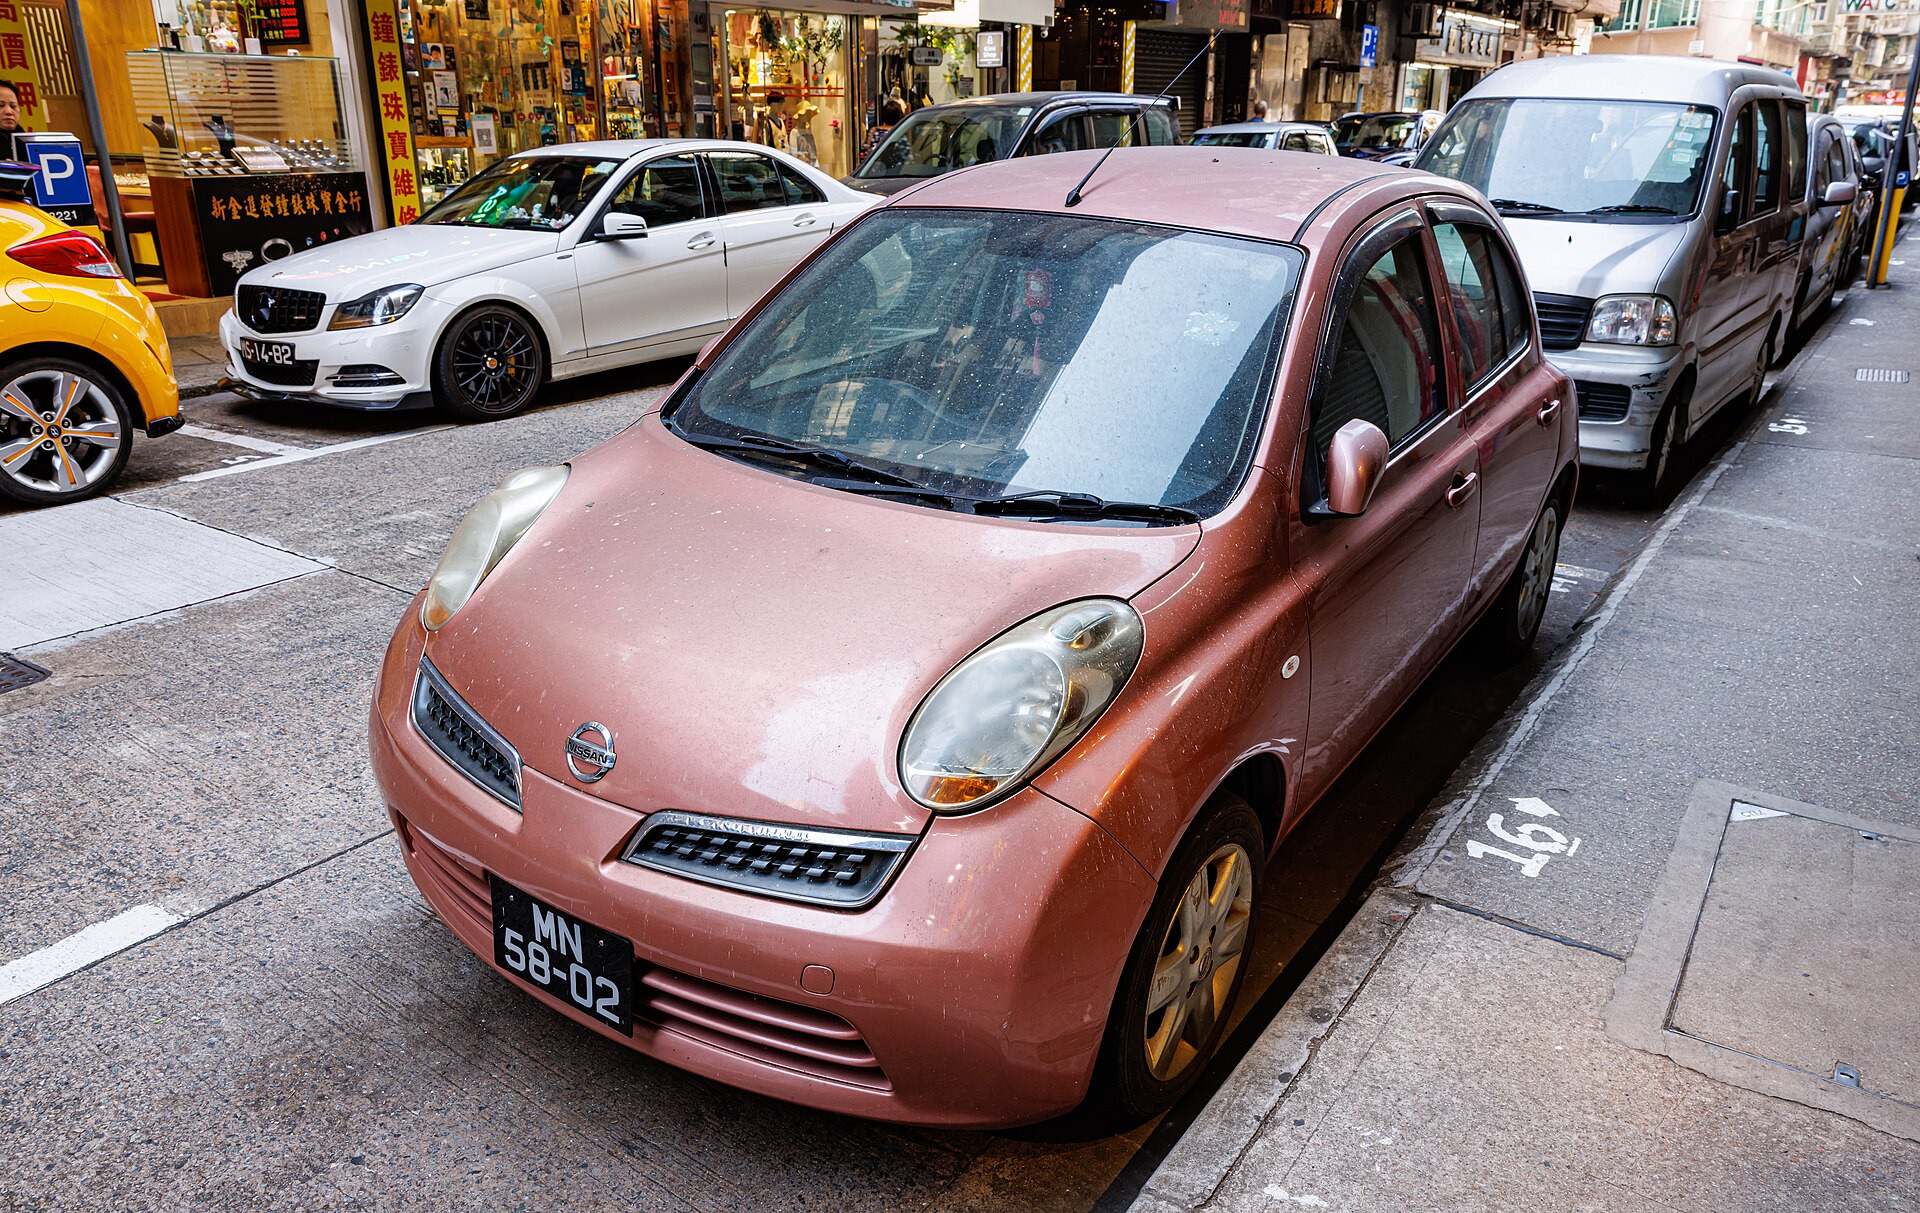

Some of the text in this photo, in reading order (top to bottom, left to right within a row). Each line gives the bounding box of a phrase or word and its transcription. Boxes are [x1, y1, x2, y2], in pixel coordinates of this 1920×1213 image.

[39, 153, 74, 195] P
[568, 741, 608, 764] NISSAN
[532, 902, 584, 964] MN
[504, 927, 620, 1024] 58-02
